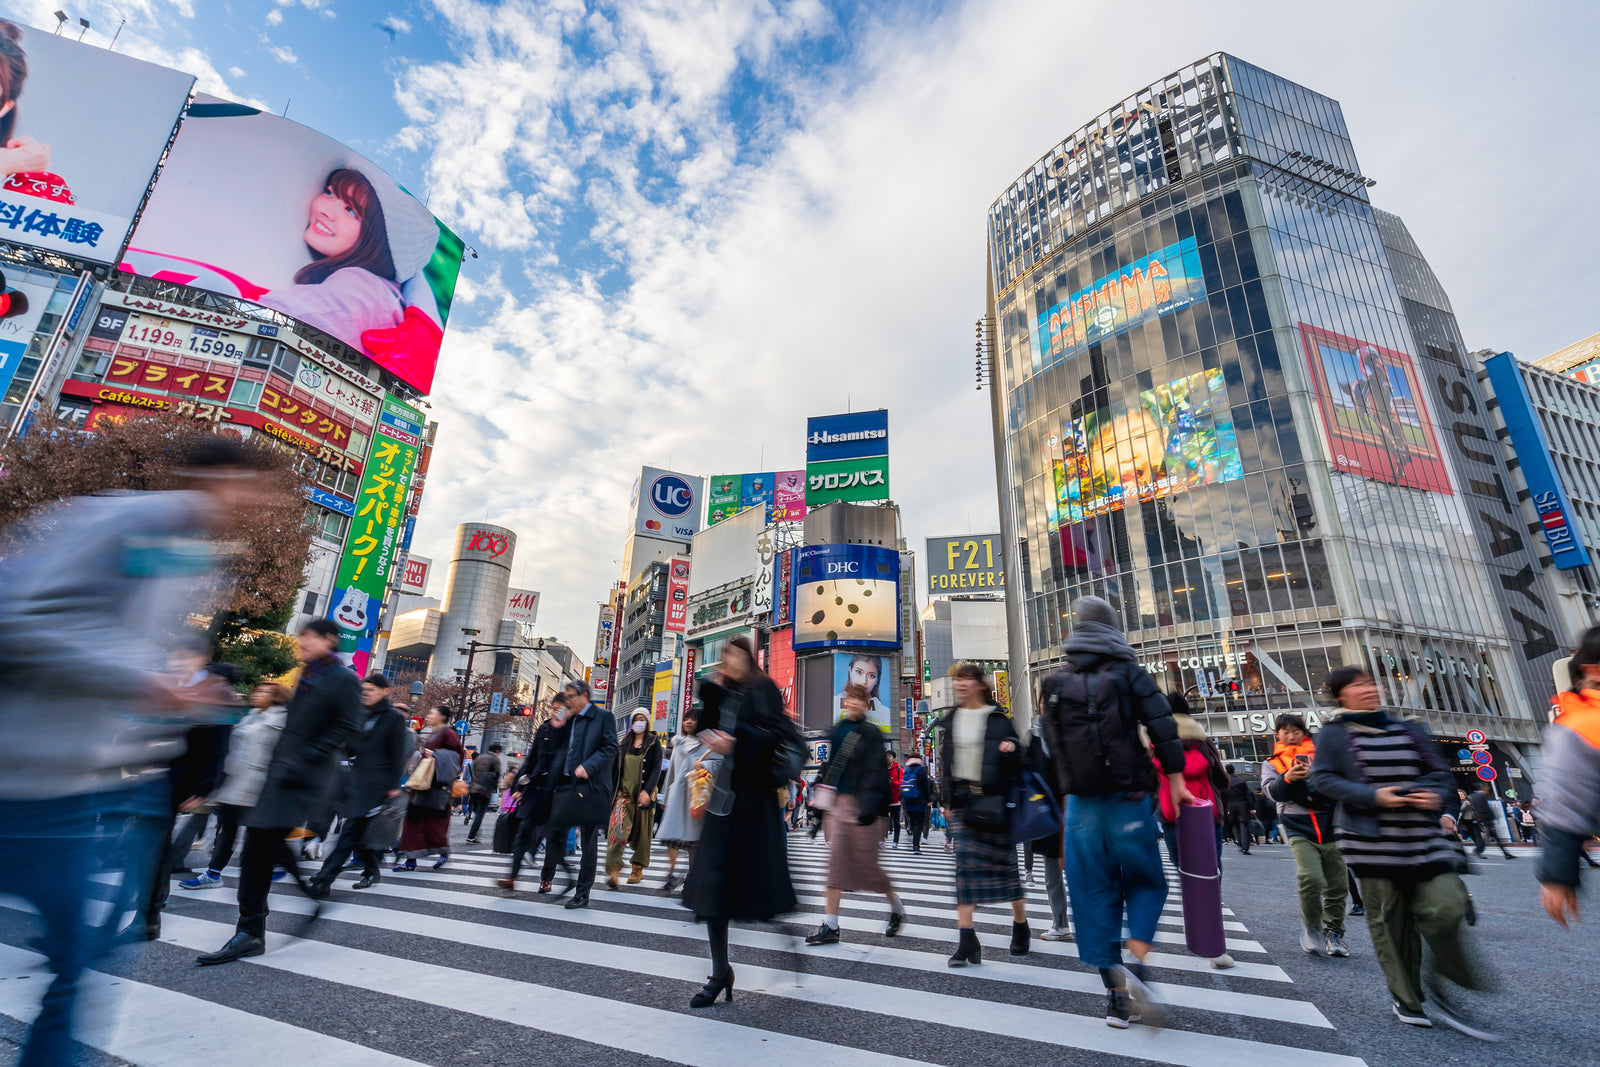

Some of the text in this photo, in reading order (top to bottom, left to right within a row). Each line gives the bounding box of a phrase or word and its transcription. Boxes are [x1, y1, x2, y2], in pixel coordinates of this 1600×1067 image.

[3, 173, 76, 201] んです。
[1050, 260, 1168, 332] MISHIMA
[98, 316, 124, 330] 9F
[128, 324, 183, 348] 1,199円
[189, 335, 244, 360] 1,599円
[111, 358, 227, 395] プライス
[325, 378, 375, 416] しゃぶ葉
[57, 406, 90, 422] 7F
[261, 387, 348, 441] コンタクト
[807, 429, 887, 445] Hisamitsu
[317, 446, 356, 472] ガスト
[808, 469, 885, 491] サロンパス
[654, 483, 690, 508] UC
[1424, 340, 1559, 662] TSUTAYA
[675, 527, 694, 536] VISA
[1534, 490, 1576, 556] SEIBU
[466, 534, 508, 558] 109
[947, 539, 994, 570] F21
[827, 561, 859, 574] DHC
[930, 572, 995, 590] FOREVER
[903, 609, 911, 642] neon
[1138, 652, 1248, 674] KS COFFEE
[1412, 653, 1496, 681] TSUTAYA
